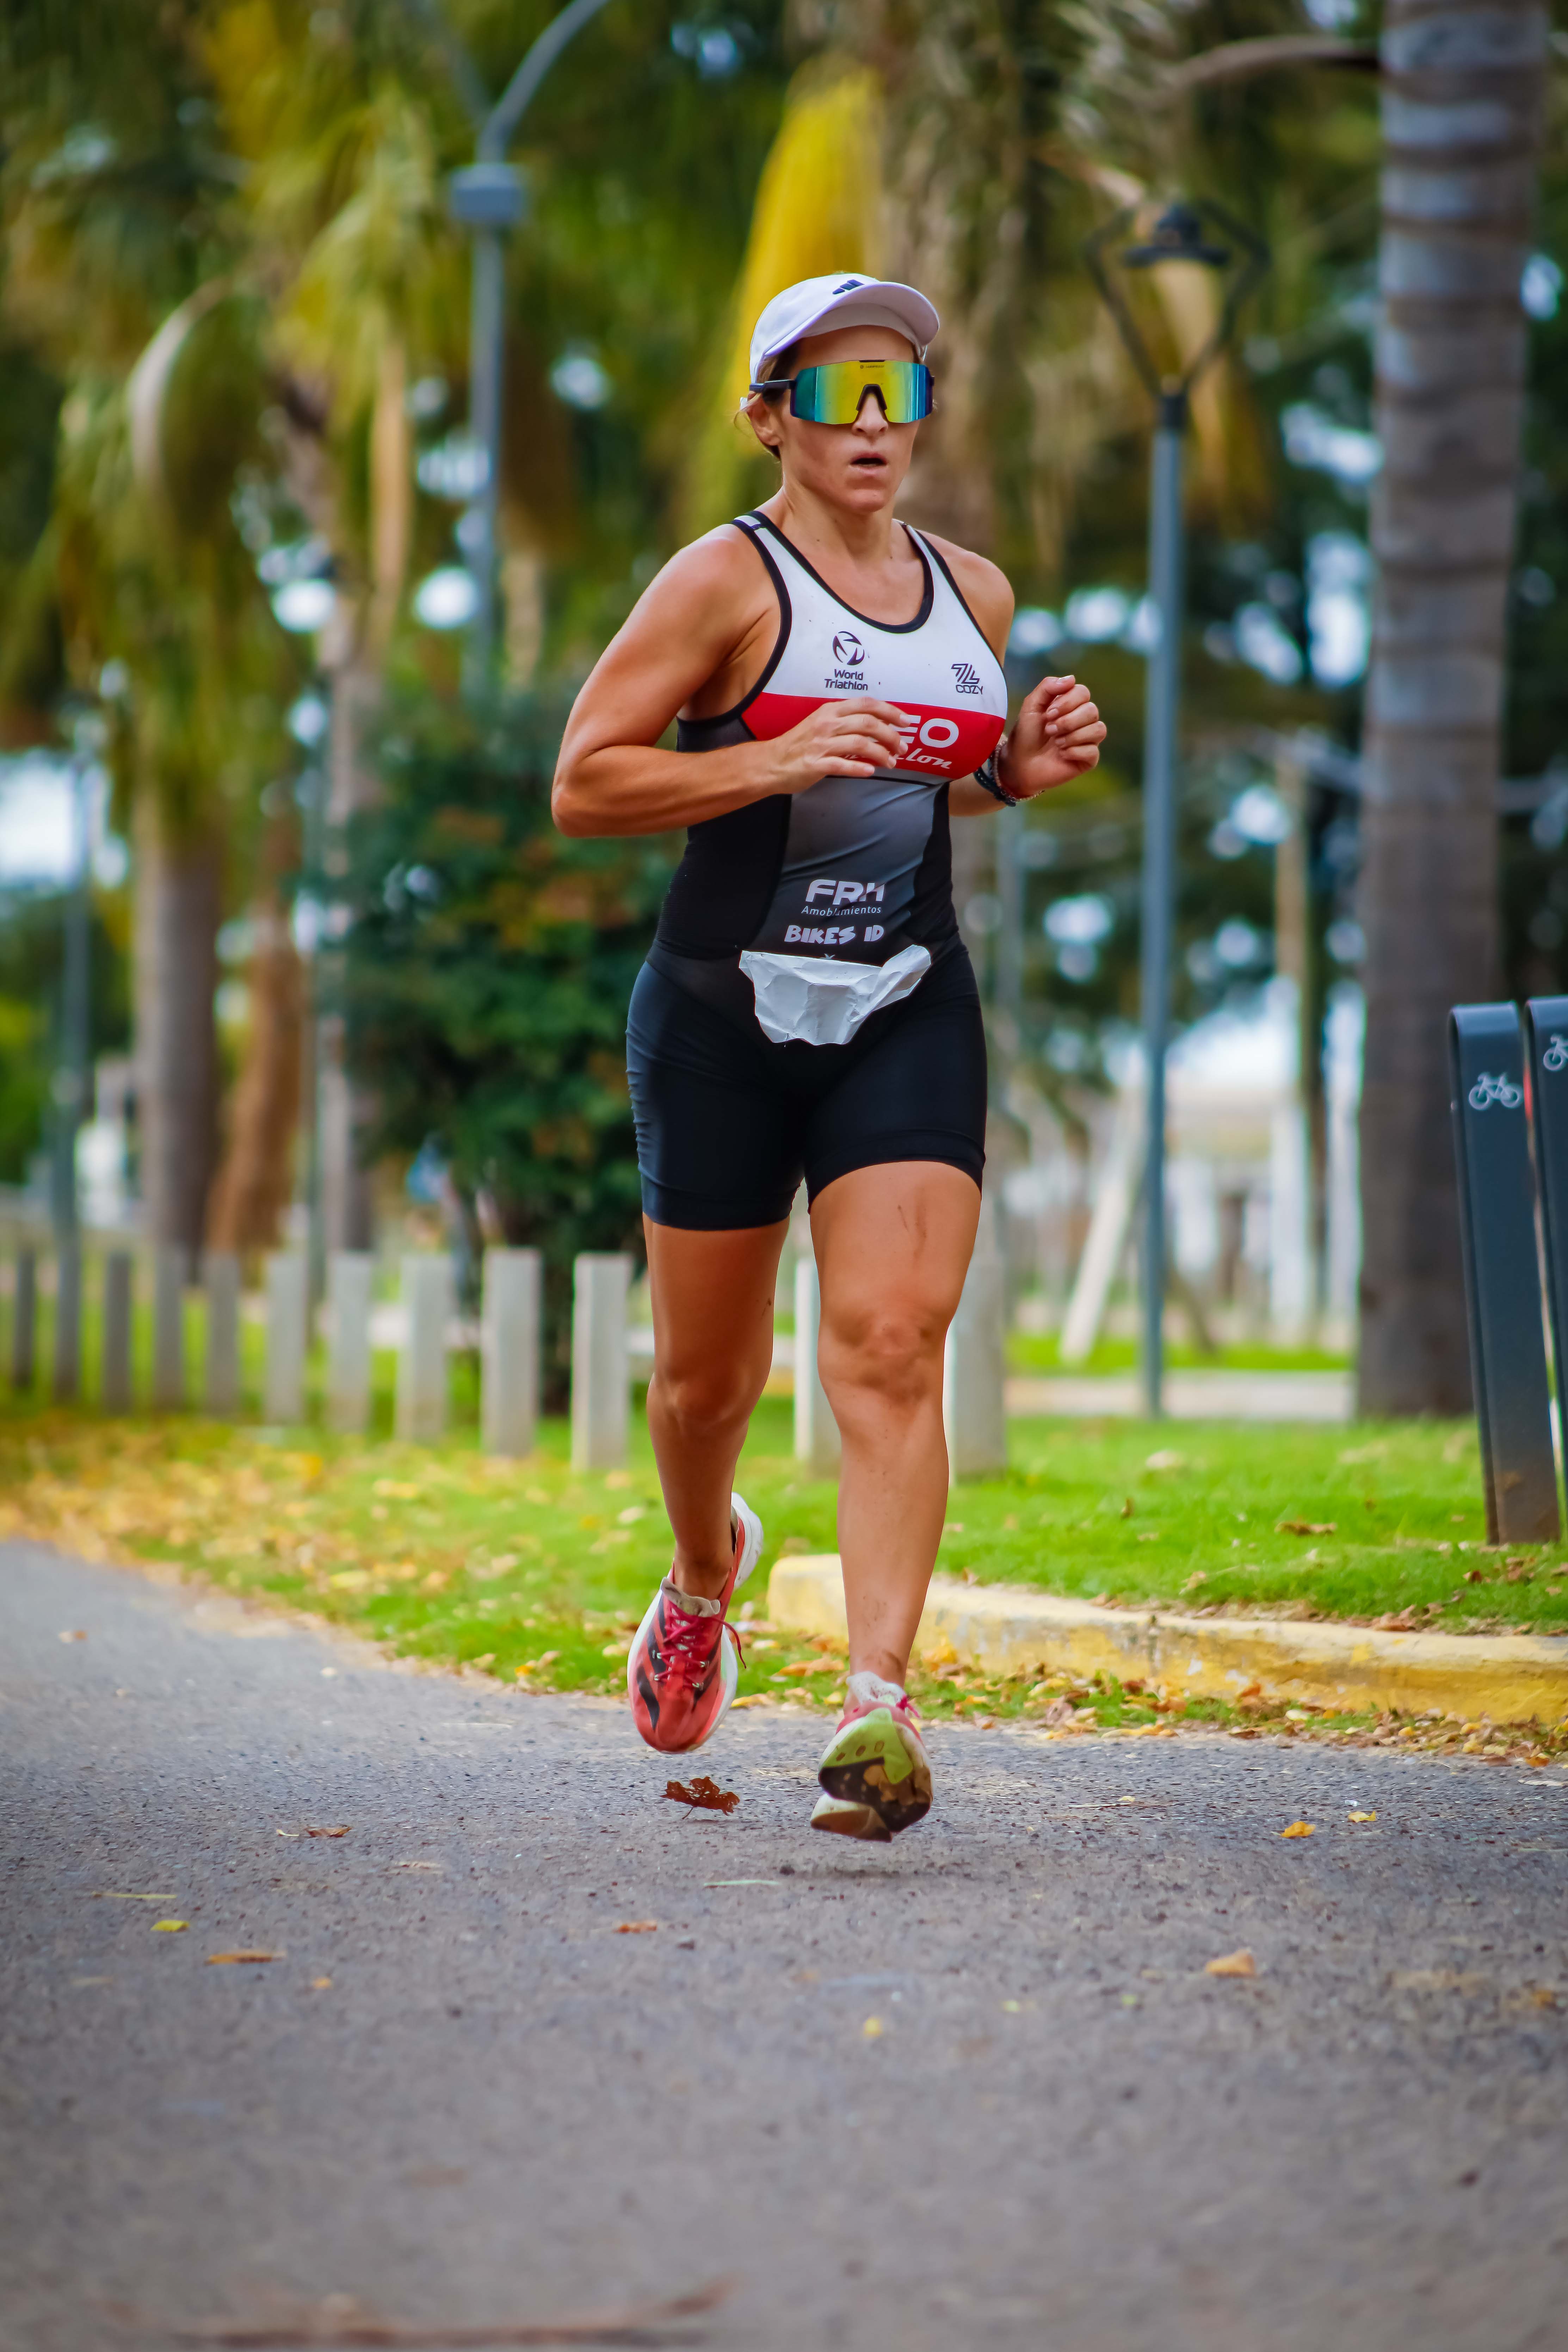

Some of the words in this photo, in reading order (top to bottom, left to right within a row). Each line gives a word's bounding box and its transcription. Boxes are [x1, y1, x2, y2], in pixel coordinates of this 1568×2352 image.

[834, 669, 864, 680] World
[824, 679, 868, 691] Triathlon
[956, 685, 983, 695] COZY
[888, 715, 959, 748] EO
[784, 925, 856, 944] BIKES
[864, 925, 884, 942] ID
